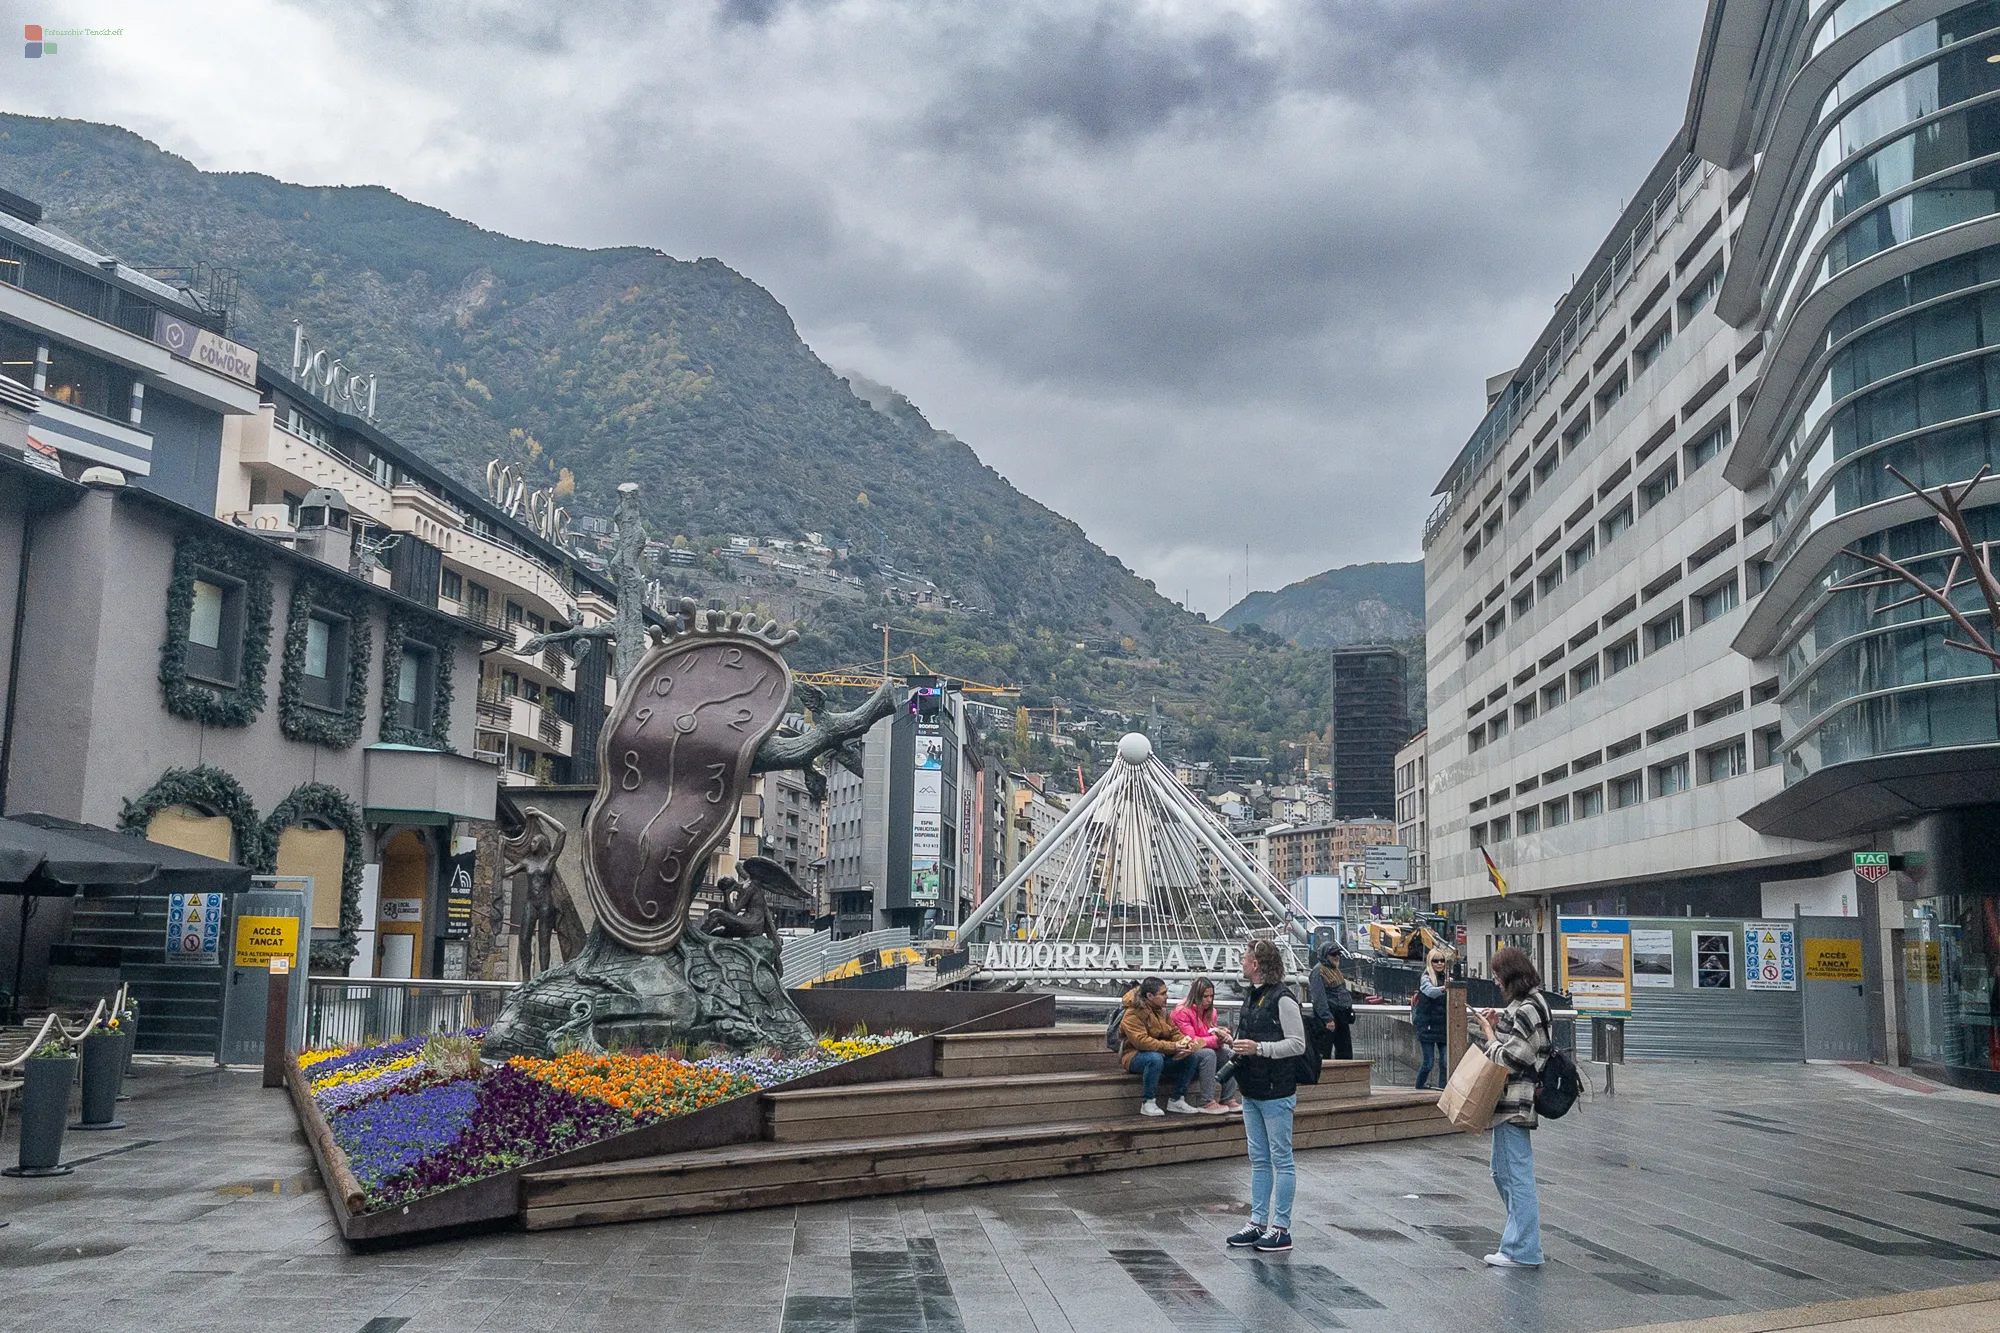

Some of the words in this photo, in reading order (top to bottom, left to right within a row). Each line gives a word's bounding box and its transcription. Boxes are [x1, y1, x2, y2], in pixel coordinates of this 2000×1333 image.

[199, 344, 252, 379] COWORK
[716, 648, 745, 669] 12
[647, 676, 674, 698] 10
[635, 707, 654, 737] 9
[725, 708, 754, 733] 2
[621, 750, 642, 792] 8
[705, 762, 726, 804] 3
[658, 845, 685, 883] 5
[1857, 854, 1887, 864] TAG
[1857, 866, 1888, 880] HEUER
[249, 937, 284, 946] TANCAT
[983, 940, 1130, 969] ANDORRA
[1139, 943, 1190, 970] LA
[1817, 960, 1849, 968] TANCAT
